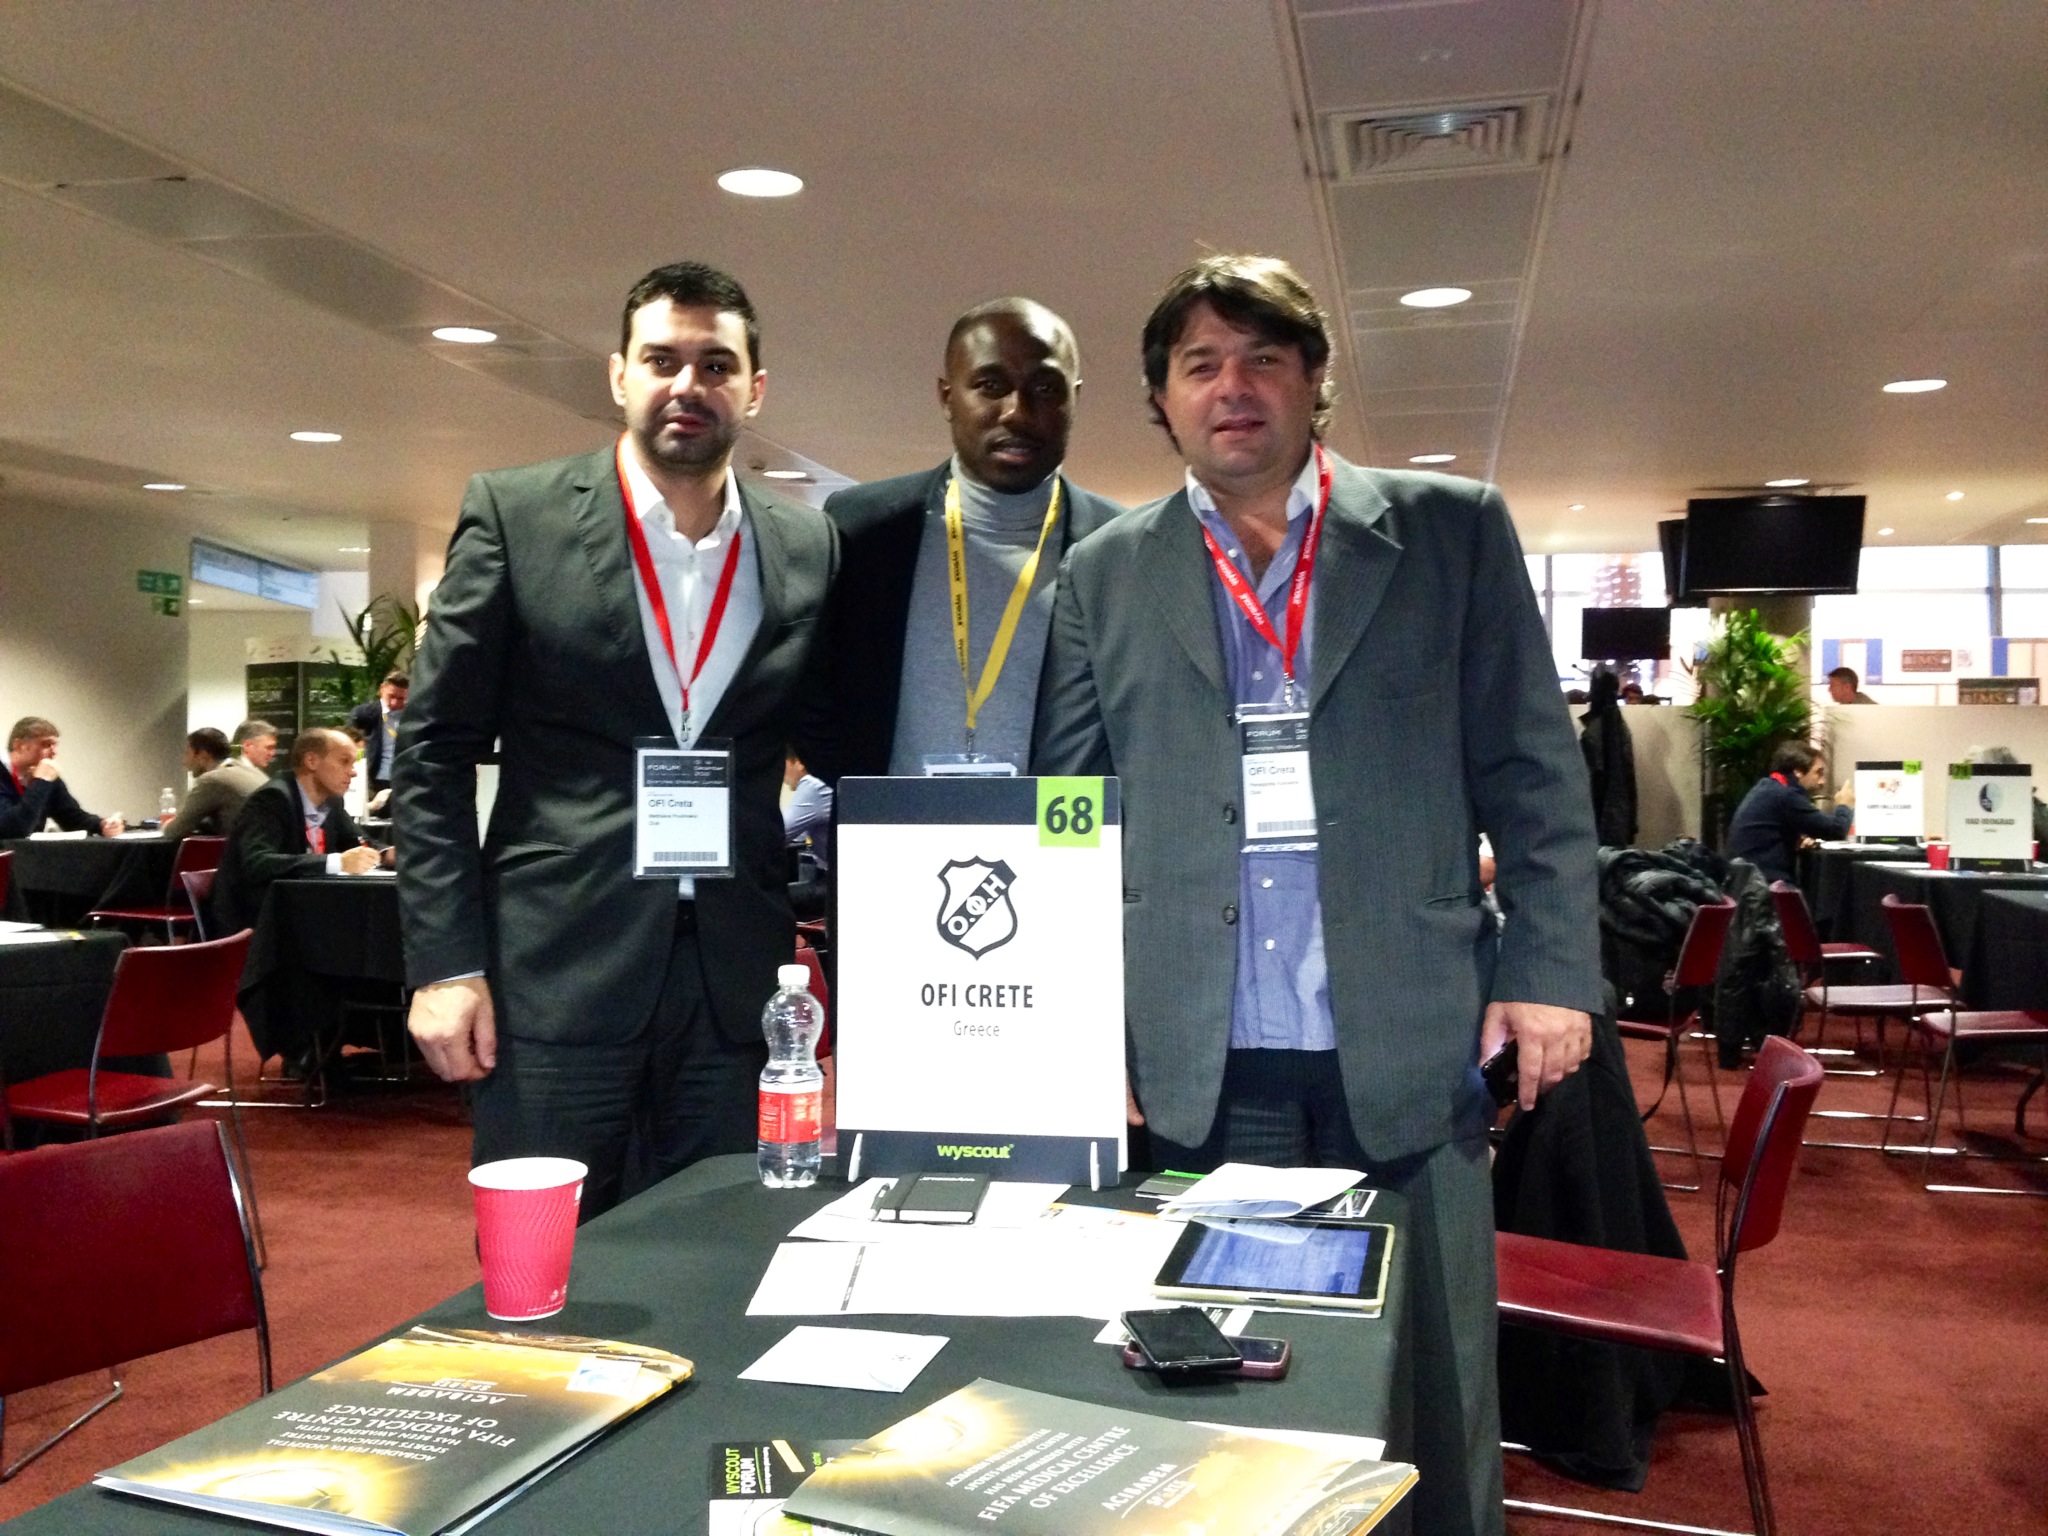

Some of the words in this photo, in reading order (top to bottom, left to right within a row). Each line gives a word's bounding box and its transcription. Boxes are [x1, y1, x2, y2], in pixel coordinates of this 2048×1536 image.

[1292, 570, 1308, 606] wyscout
[1045, 795, 1094, 835] 68
[920, 982, 957, 1007] OFI
[964, 983, 1034, 1009] CRETE
[953, 1020, 1001, 1038] Greece
[936, 1144, 1011, 1161] wyscout
[386, 1387, 506, 1404] ACIBADEM
[273, 1411, 362, 1427] CENTRE
[324, 1404, 462, 1423] EXCELLENCE
[295, 1424, 332, 1433] WITH
[365, 1419, 466, 1436] MEDICAL
[463, 1417, 498, 1428] OF
[280, 1431, 331, 1441] CENTRE
[333, 1428, 398, 1438] AWARDED
[398, 1432, 433, 1441] BEEN
[433, 1437, 462, 1446] HAS
[468, 1429, 516, 1447] FIFA
[398, 1441, 449, 1454] SPORTS
[725, 1447, 741, 1494] WYSCOUT
[740, 1457, 756, 1494] FORUM
[977, 1494, 1022, 1521] FIFA
[1011, 1458, 1083, 1495] MEDICAL
[1072, 1426, 1131, 1460] CENTRE
[1029, 1492, 1058, 1508] OF
[1050, 1443, 1140, 1494] EXCELLENCE
[983, 1482, 1007, 1496] HAS
[1101, 1463, 1178, 1511] ACIBADEM
